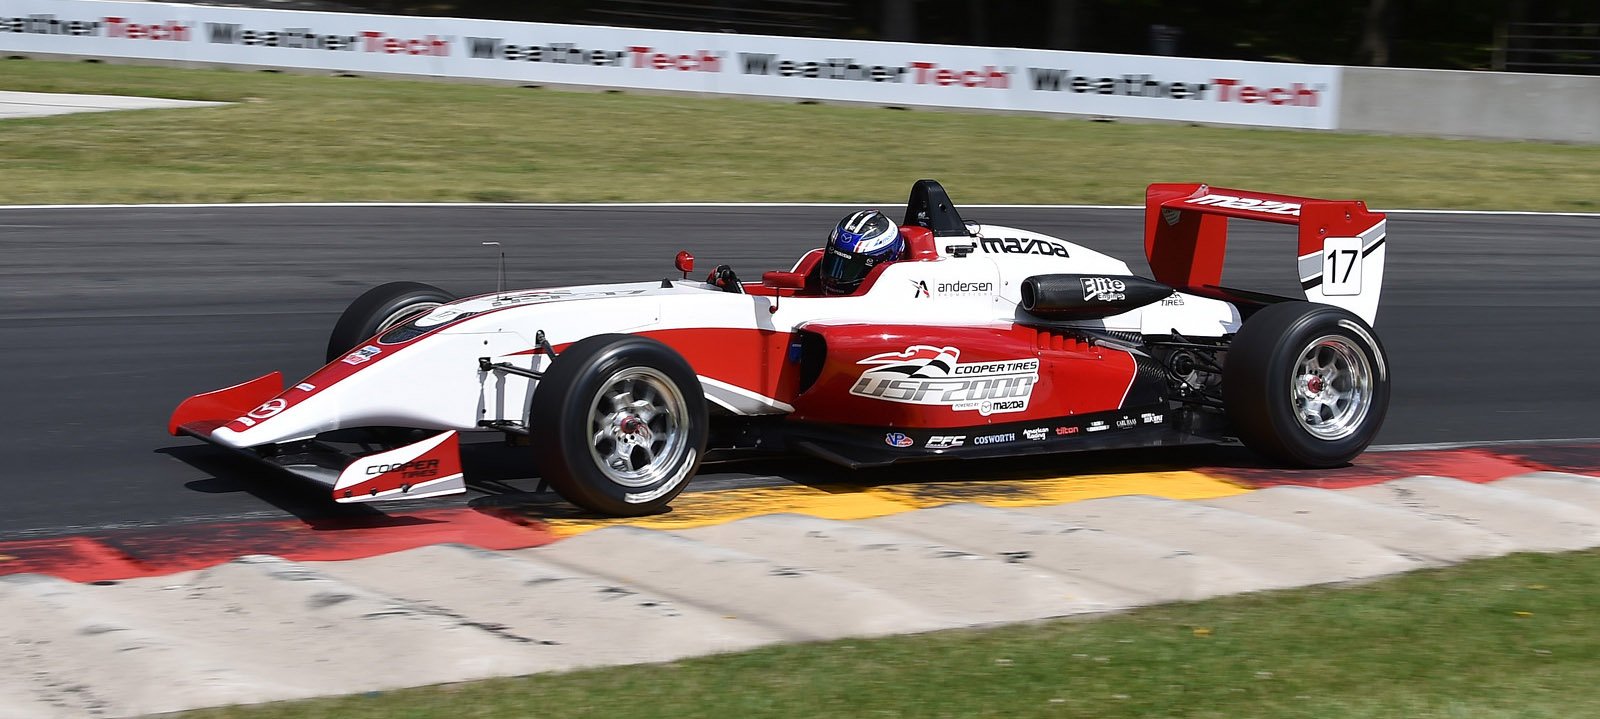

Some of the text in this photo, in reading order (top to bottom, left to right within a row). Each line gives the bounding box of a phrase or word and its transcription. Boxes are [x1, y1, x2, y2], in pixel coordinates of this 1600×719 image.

[204, 22, 450, 56] WeatherTech
[465, 37, 720, 72] WeatherTech
[738, 53, 1010, 88] WeatherTech
[1027, 68, 1319, 106] WeatherTech
[1184, 194, 1301, 216] mazd
[980, 238, 1070, 258] mazda
[1327, 249, 1358, 284] 17
[938, 280, 993, 292] andersen
[1080, 278, 1125, 300] Elite
[955, 361, 1037, 375] COOPER TIRES
[852, 375, 1034, 402] USF2000
[993, 400, 1024, 411] mazda
[1022, 427, 1049, 436] American
[1055, 426, 1079, 435] tilton
[926, 436, 967, 446] PFC
[974, 433, 1015, 445] COSWORTH
[366, 459, 439, 475] COOPER
